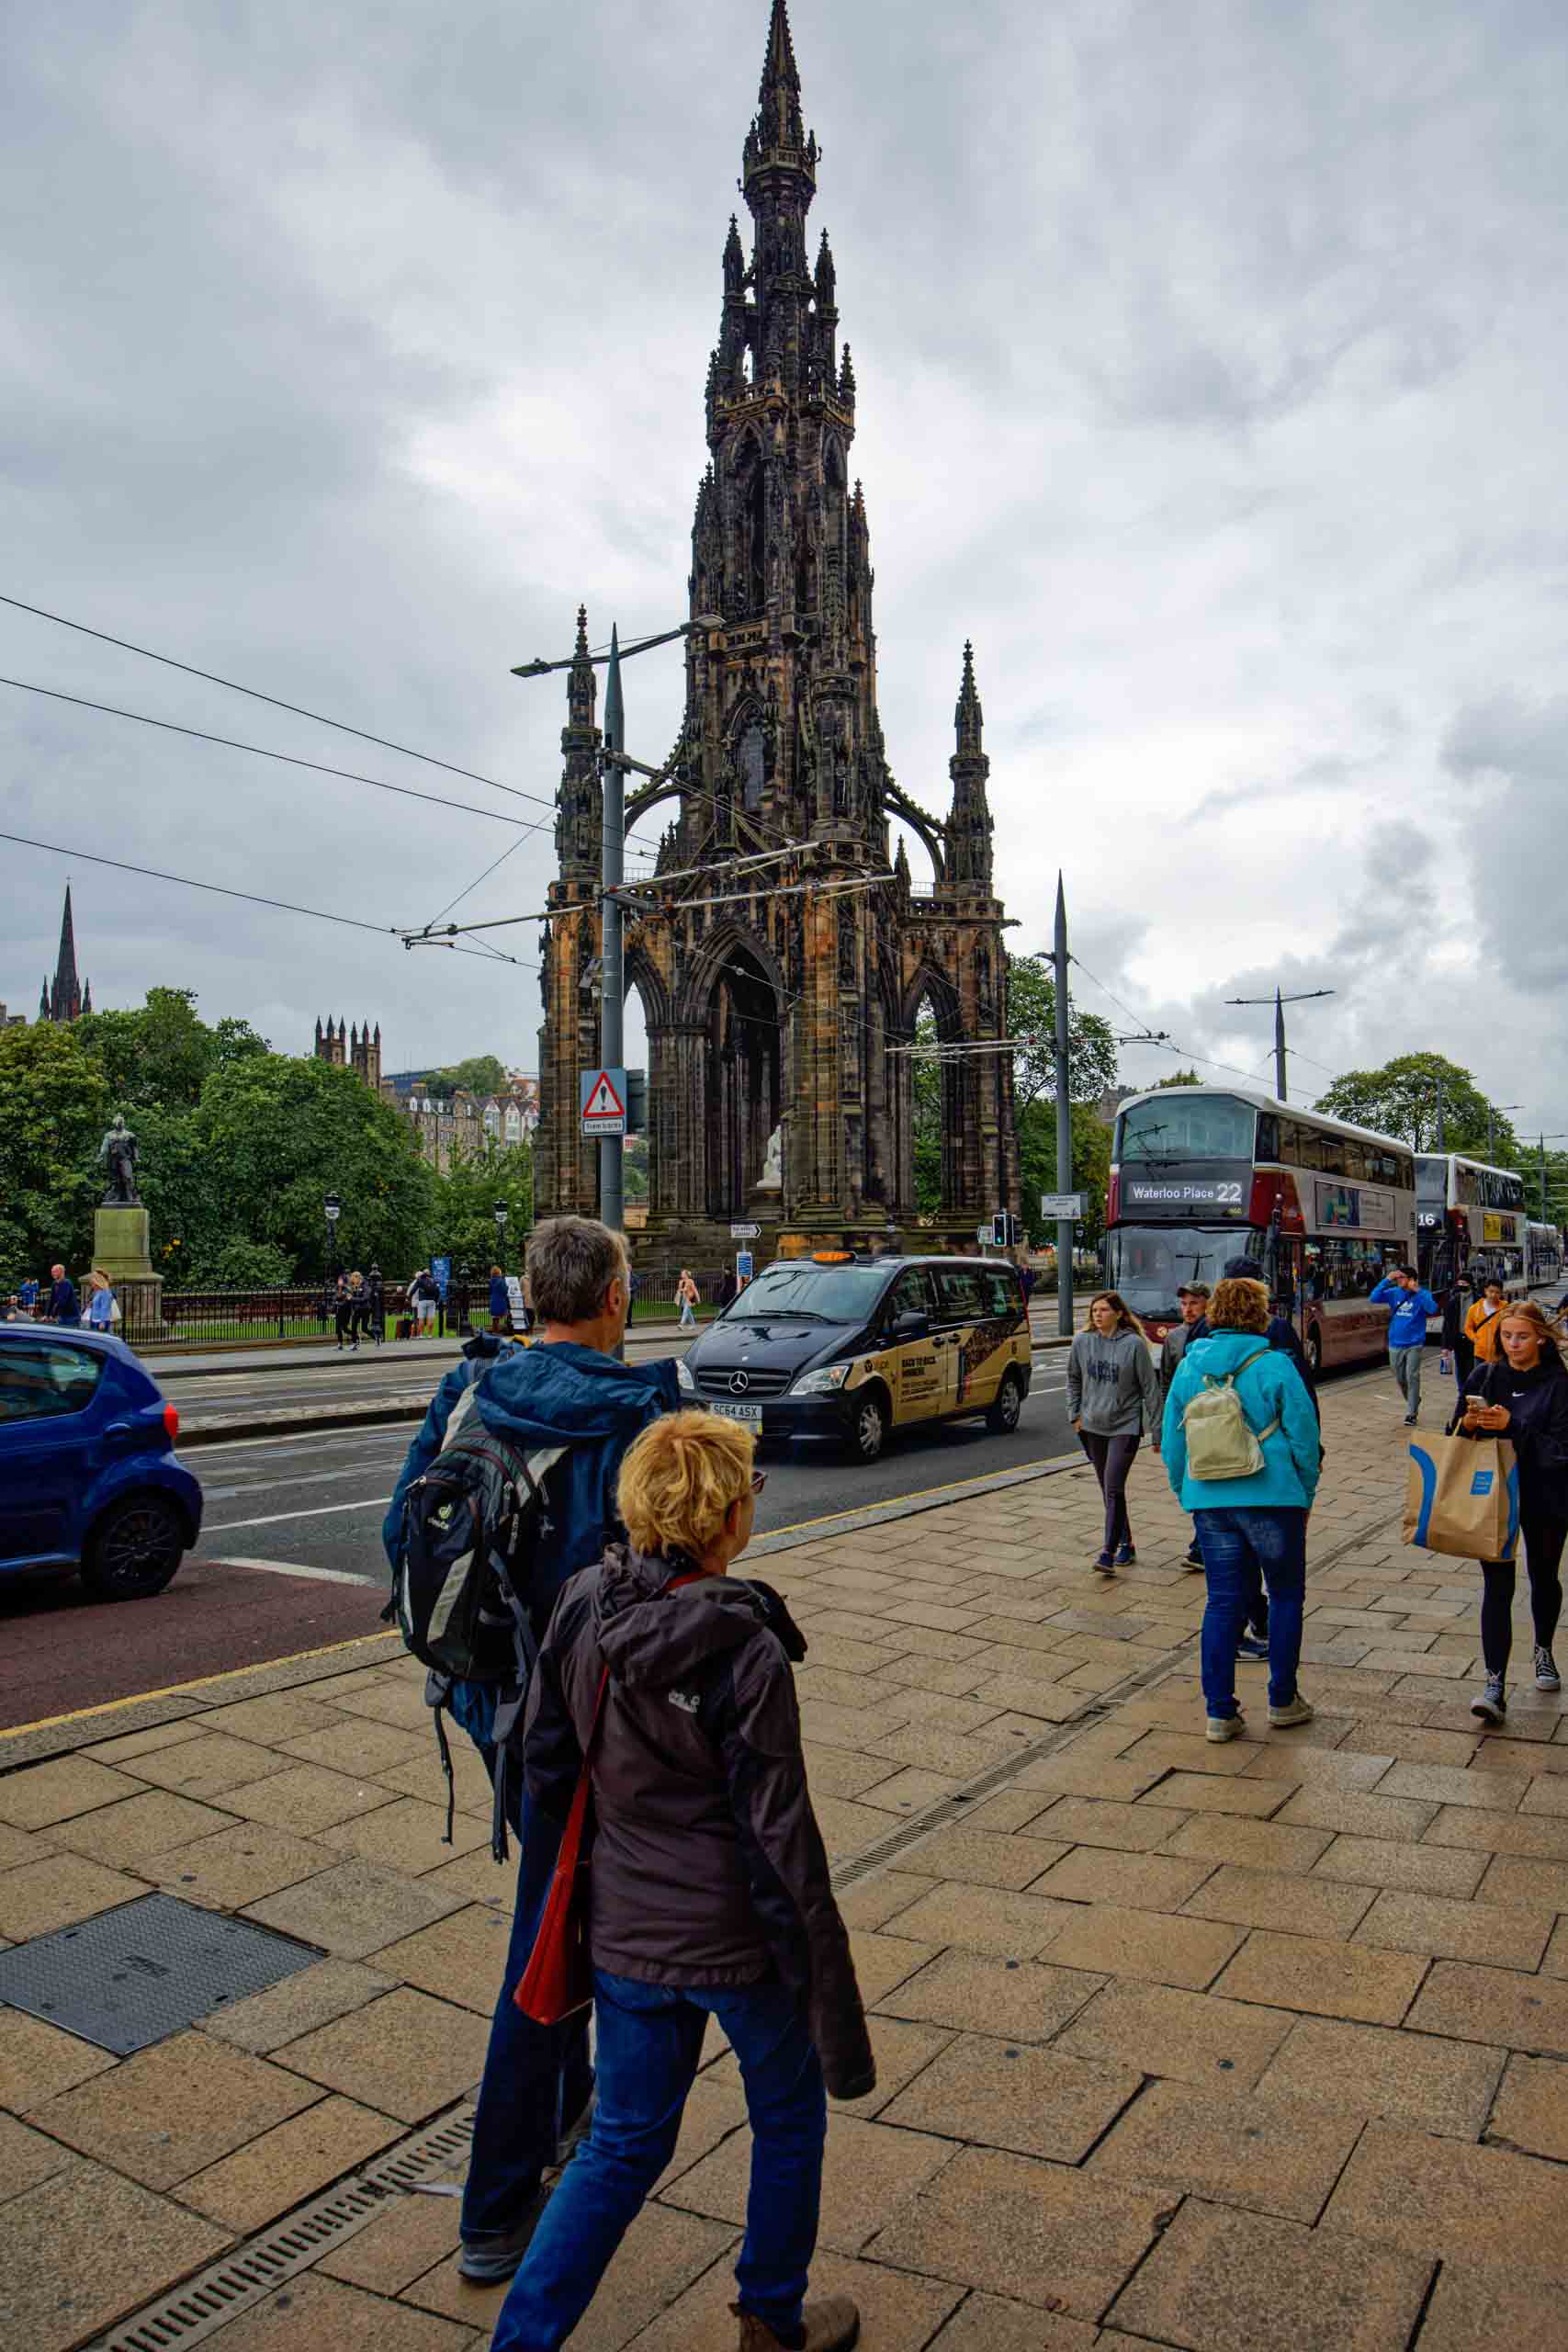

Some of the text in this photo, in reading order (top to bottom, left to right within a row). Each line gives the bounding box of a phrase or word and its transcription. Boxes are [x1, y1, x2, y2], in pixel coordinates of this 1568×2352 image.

[1133, 1182, 1243, 1202] Waterloo Place 22
[1417, 1213, 1436, 1227] 16
[714, 1404, 758, 1419] SC64 ASX
